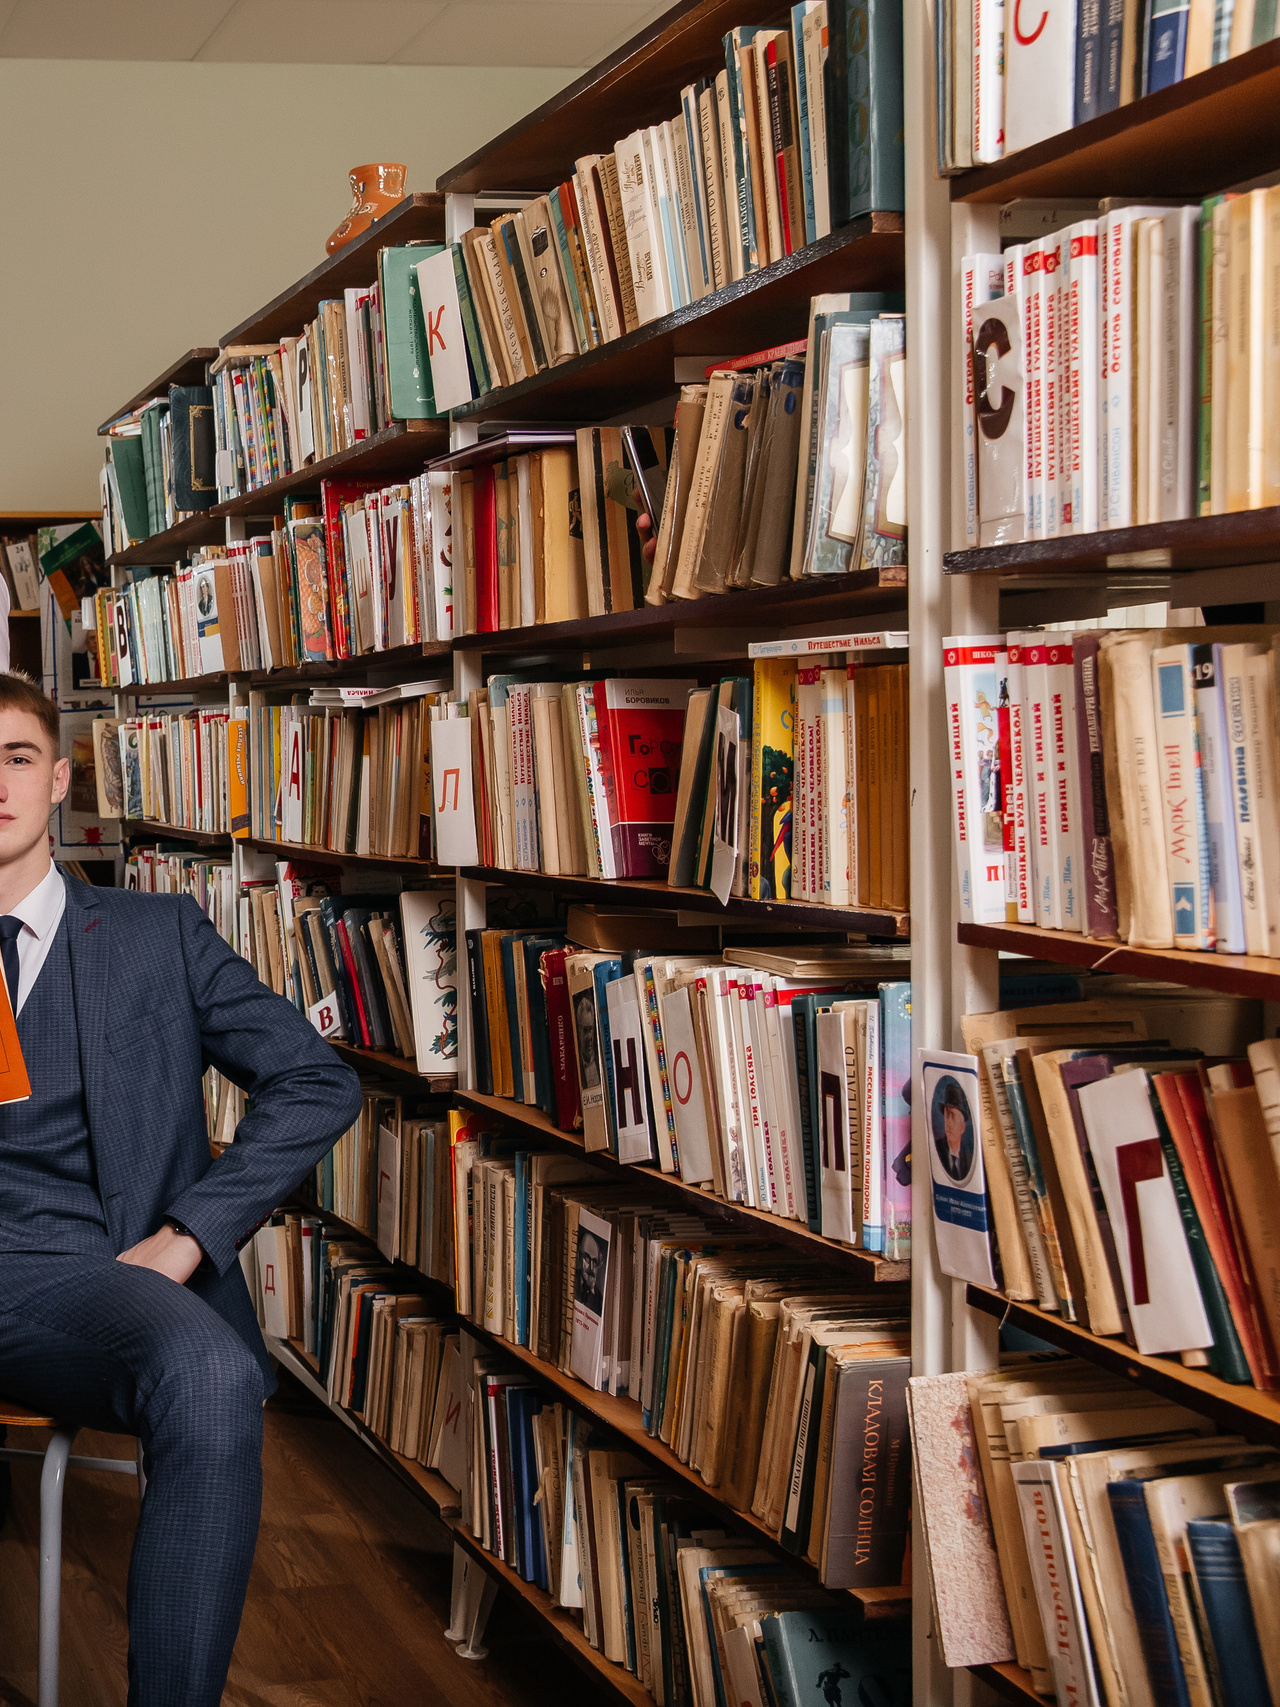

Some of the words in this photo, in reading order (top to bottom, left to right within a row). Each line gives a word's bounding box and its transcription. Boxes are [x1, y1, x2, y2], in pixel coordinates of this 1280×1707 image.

[677, 144, 688, 199] КОЖЕВНИКОВ
[684, 202, 692, 231] ВАДИМ
[738, 177, 749, 225] КАССИЛЬ
[741, 228, 750, 246] ЛЕВ
[1110, 223, 1123, 305] СОКРОВИЩ
[428, 305, 446, 357] К
[508, 331, 519, 358] Лев
[1032, 292, 1041, 372] ГУЛЛИВЕРА
[1046, 294, 1055, 374] ГУЛЛИВЕРА
[1110, 313, 1121, 373] ОСТРОВ
[975, 318, 1015, 440] С
[1033, 379, 1041, 477] ПУТЕШЕСТВИЯ
[1046, 381, 1055, 481] ПУТЕШЕСТВИЯ
[807, 638, 852, 650] ПУТЕШЕСТВИЕ
[853, 635, 881, 647] НИЛЬСА
[624, 688, 644, 696] ИЛЬЯ
[1194, 661, 1214, 681] 19
[625, 696, 670, 704] БОРОВИКОВ
[1050, 693, 1065, 754] НИЩИЙ
[511, 729, 519, 786] ПУТЕШЕСТВИЕ
[518, 728, 526, 784] ПУТЕШЕСТВИЕ
[799, 718, 807, 789] ЧЕЛОВЕКОМ!
[950, 702, 962, 760] НИЩИЙ
[1010, 703, 1024, 787] ЧЕЛОВЕКОМ!
[1031, 702, 1043, 763] НИЩИЙ
[289, 730, 301, 801] А
[438, 768, 460, 812] Л
[1163, 745, 1182, 796] ТВЕН
[1234, 746, 1251, 823] ПОЛОВИНА
[956, 788, 966, 841] ПРИНЦ
[1002, 784, 1015, 825] Твен
[1015, 792, 1026, 828] БУДЬ
[1036, 791, 1048, 846] ПРИНЦ
[1057, 779, 1069, 833] ПРИНЦ
[1166, 797, 1192, 865] МАРК
[318, 1005, 334, 1031] В
[613, 1037, 644, 1129] Н
[672, 1050, 693, 1105] О
[745, 1045, 757, 1100] ТОЛСТЯКА
[865, 1066, 873, 1113] РАССКАЗЫ
[751, 1105, 760, 1128] ТРИ
[821, 1071, 846, 1172] П
[864, 1116, 872, 1157] ПАВЛИКА
[763, 1120, 775, 1177] ТОЛСТЯКА
[1003, 1124, 1034, 1224] АНТОНОВСКИЕ
[378, 1169, 391, 1204] Г
[769, 1182, 777, 1205] ТРИ
[863, 1158, 871, 1221] ПОМИДОРОВА
[1115, 1137, 1165, 1306] Г
[264, 1264, 276, 1296] Д
[445, 1392, 461, 1435] И
[796, 1397, 811, 1450] ПРИШВИН
[861, 1379, 884, 1489] КЛАДОВАЯ
[791, 1453, 804, 1498] МИХАИЛ
[494, 1503, 502, 1552] РАССКАЗЫ
[853, 1489, 876, 1567] СОЛНЦА
[1032, 1490, 1073, 1665] Лермонтов
